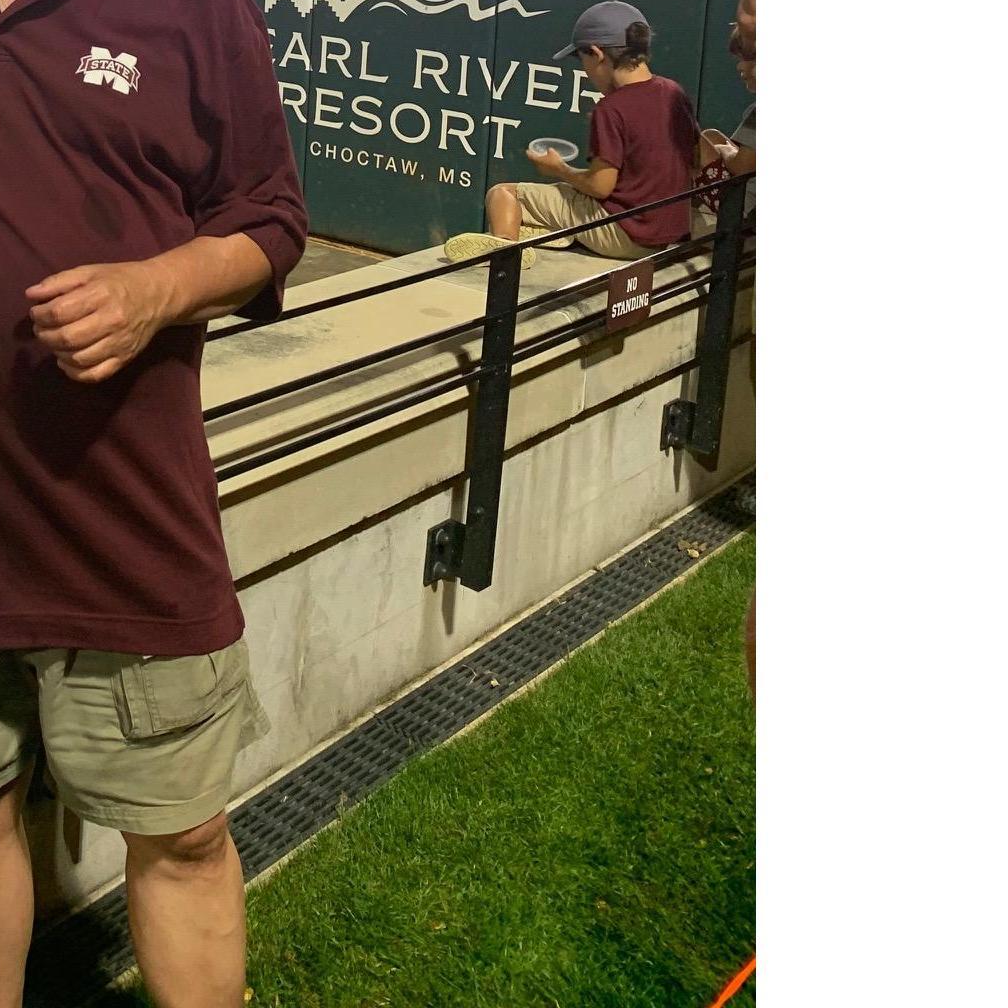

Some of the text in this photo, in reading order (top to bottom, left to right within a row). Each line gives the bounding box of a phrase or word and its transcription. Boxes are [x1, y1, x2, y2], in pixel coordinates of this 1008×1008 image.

[90, 59, 131, 81] STATE
[309, 141, 472, 188] CHOCTAW, MS
[626, 276, 638, 293] NO
[611, 292, 650, 319] STANDING
